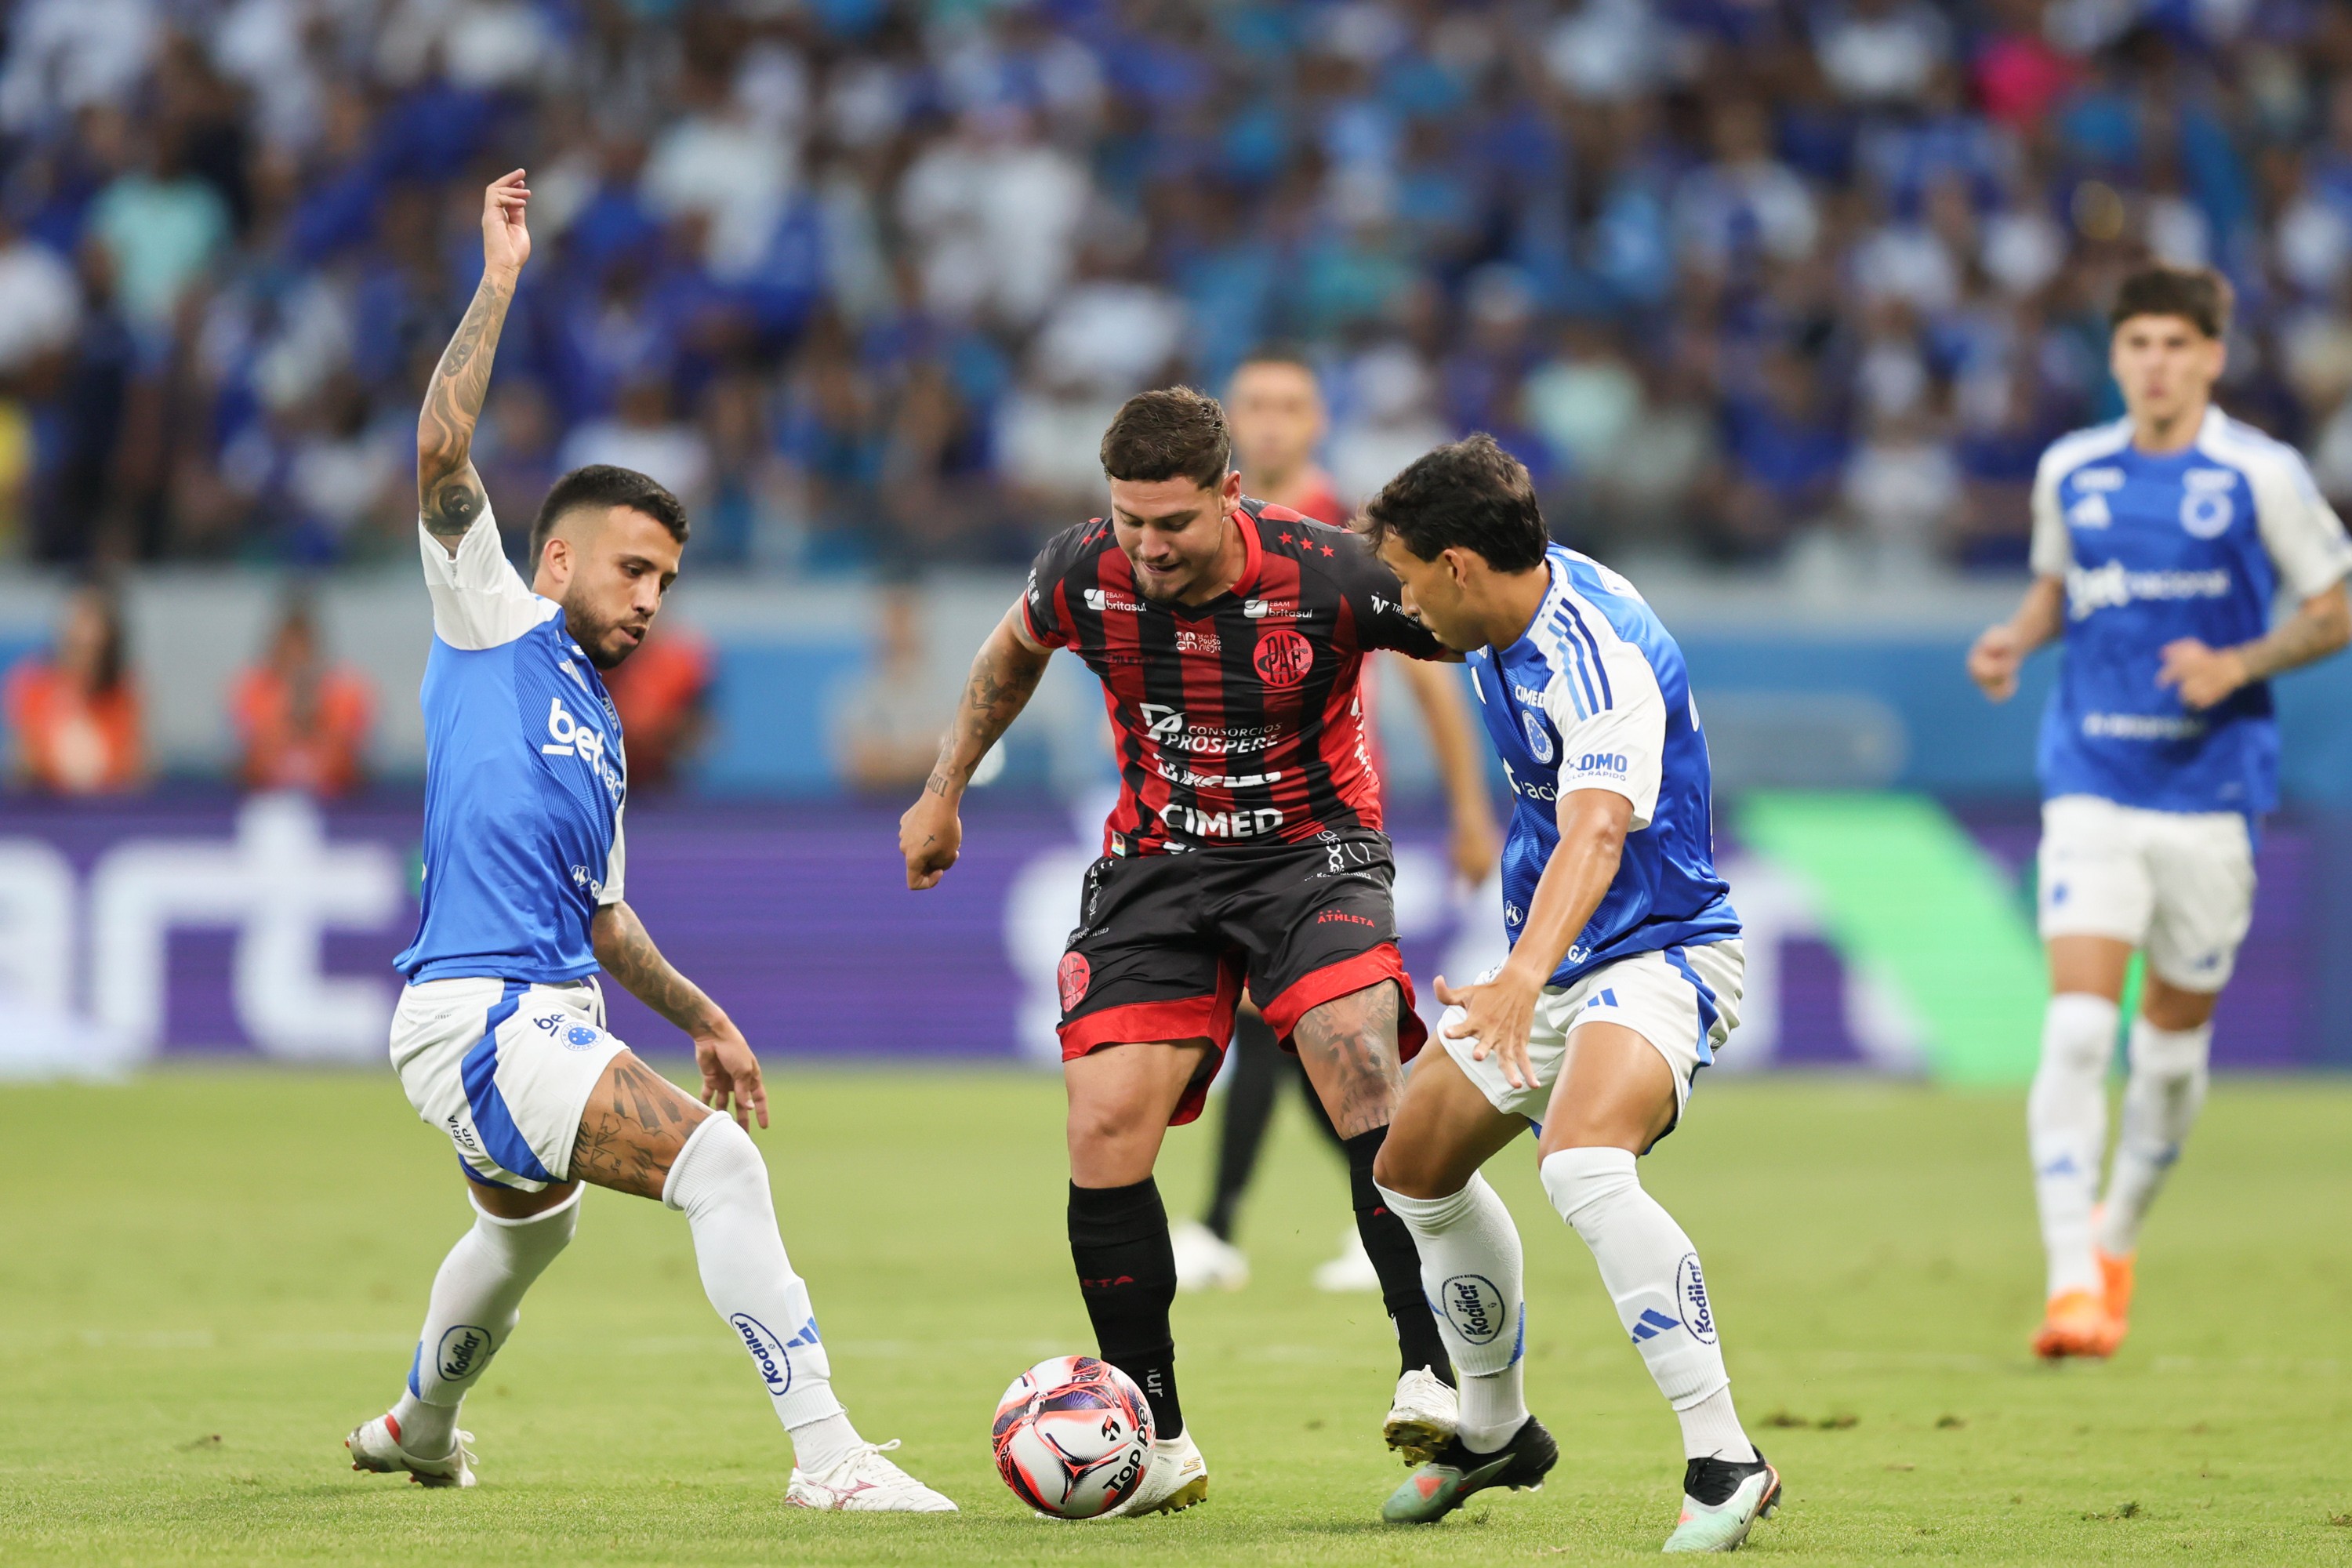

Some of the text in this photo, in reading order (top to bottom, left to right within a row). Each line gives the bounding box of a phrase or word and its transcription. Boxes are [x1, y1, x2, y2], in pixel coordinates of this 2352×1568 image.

[1106, 600, 1147, 612] britasul
[1269, 608, 1313, 619] britasul
[542, 696, 604, 776] bet
[1164, 732, 1280, 753] PROSPERE
[1158, 803, 1284, 838] CIMED
[1317, 913, 1375, 928] ATHLETA
[1454, 1282, 1492, 1335] Kodilar
[1687, 1261, 1713, 1334] Kodilar
[445, 1331, 481, 1375] Kodilar
[735, 1321, 783, 1384] Kodilar
